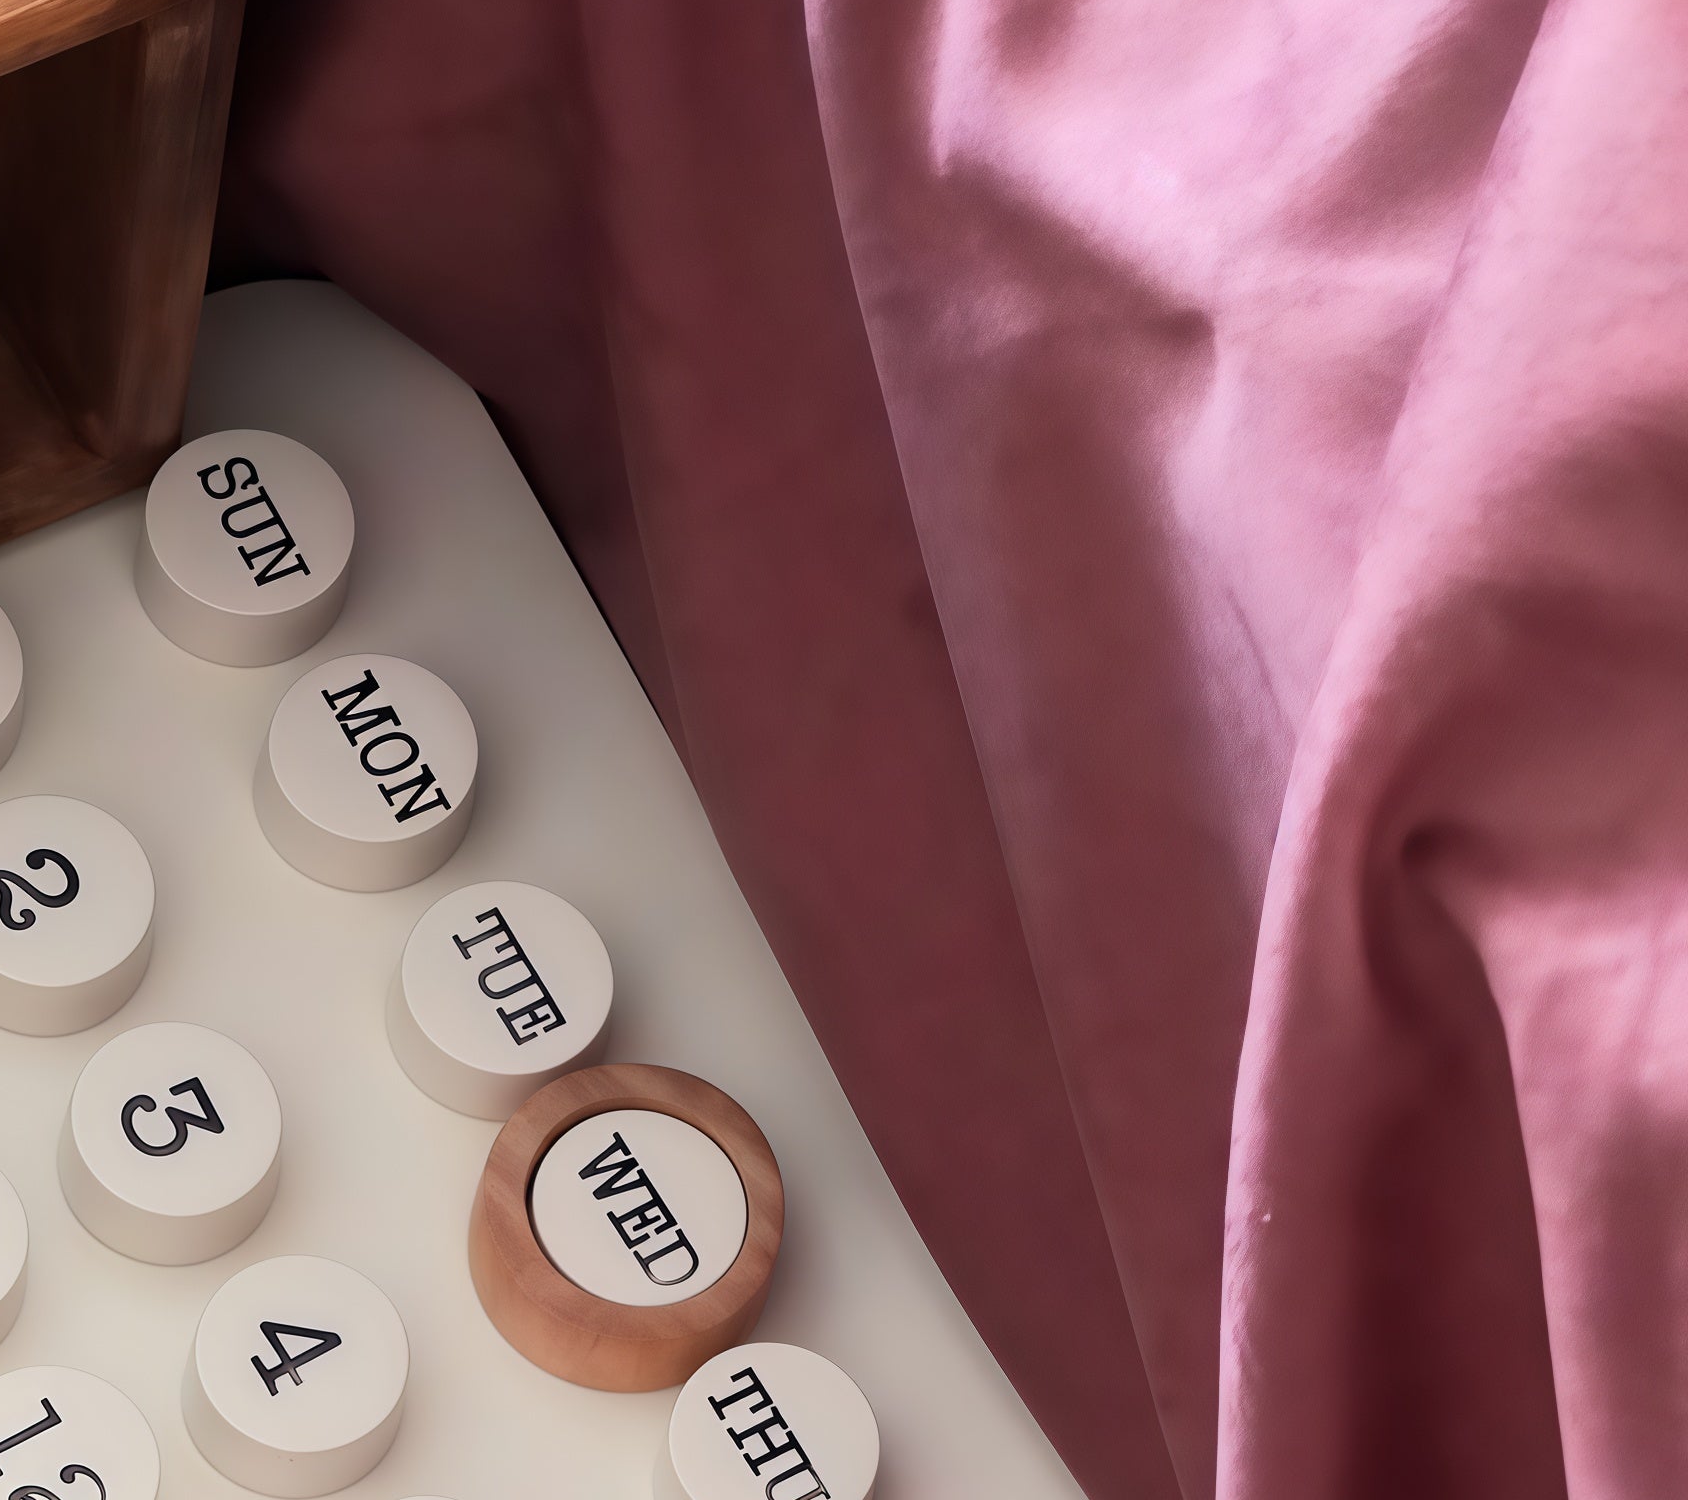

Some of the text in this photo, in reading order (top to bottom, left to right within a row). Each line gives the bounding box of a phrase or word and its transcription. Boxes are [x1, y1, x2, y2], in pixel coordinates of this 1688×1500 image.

[197, 457, 311, 587] SUN
[321, 669, 451, 823] MON
[452, 907, 566, 1046] TUE
[121, 1077, 224, 1157] 3
[578, 1132, 699, 1286] WED
[251, 1321, 342, 1396] 4
